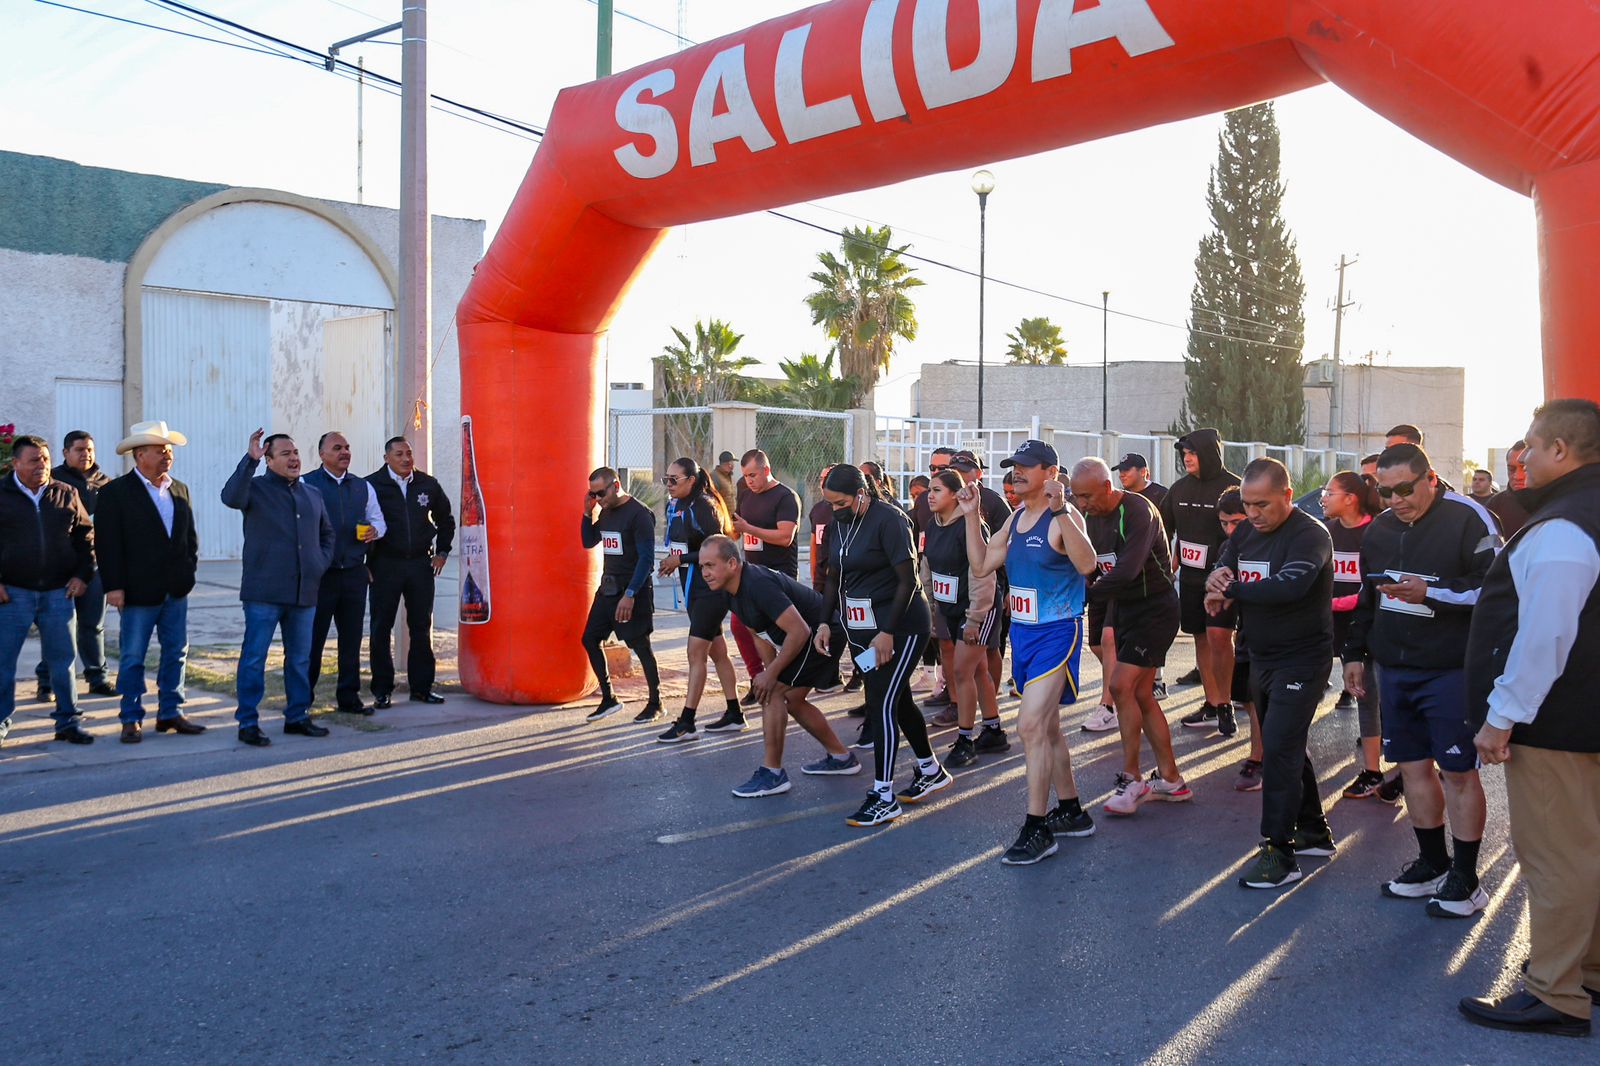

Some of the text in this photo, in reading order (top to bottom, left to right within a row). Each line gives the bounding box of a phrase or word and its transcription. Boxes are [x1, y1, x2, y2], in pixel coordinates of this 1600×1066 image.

[613, 0, 1175, 179] SALIDA
[1182, 547, 1201, 561] 037
[933, 580, 951, 596] 011
[1011, 595, 1031, 614] 001
[847, 606, 865, 621] 017
